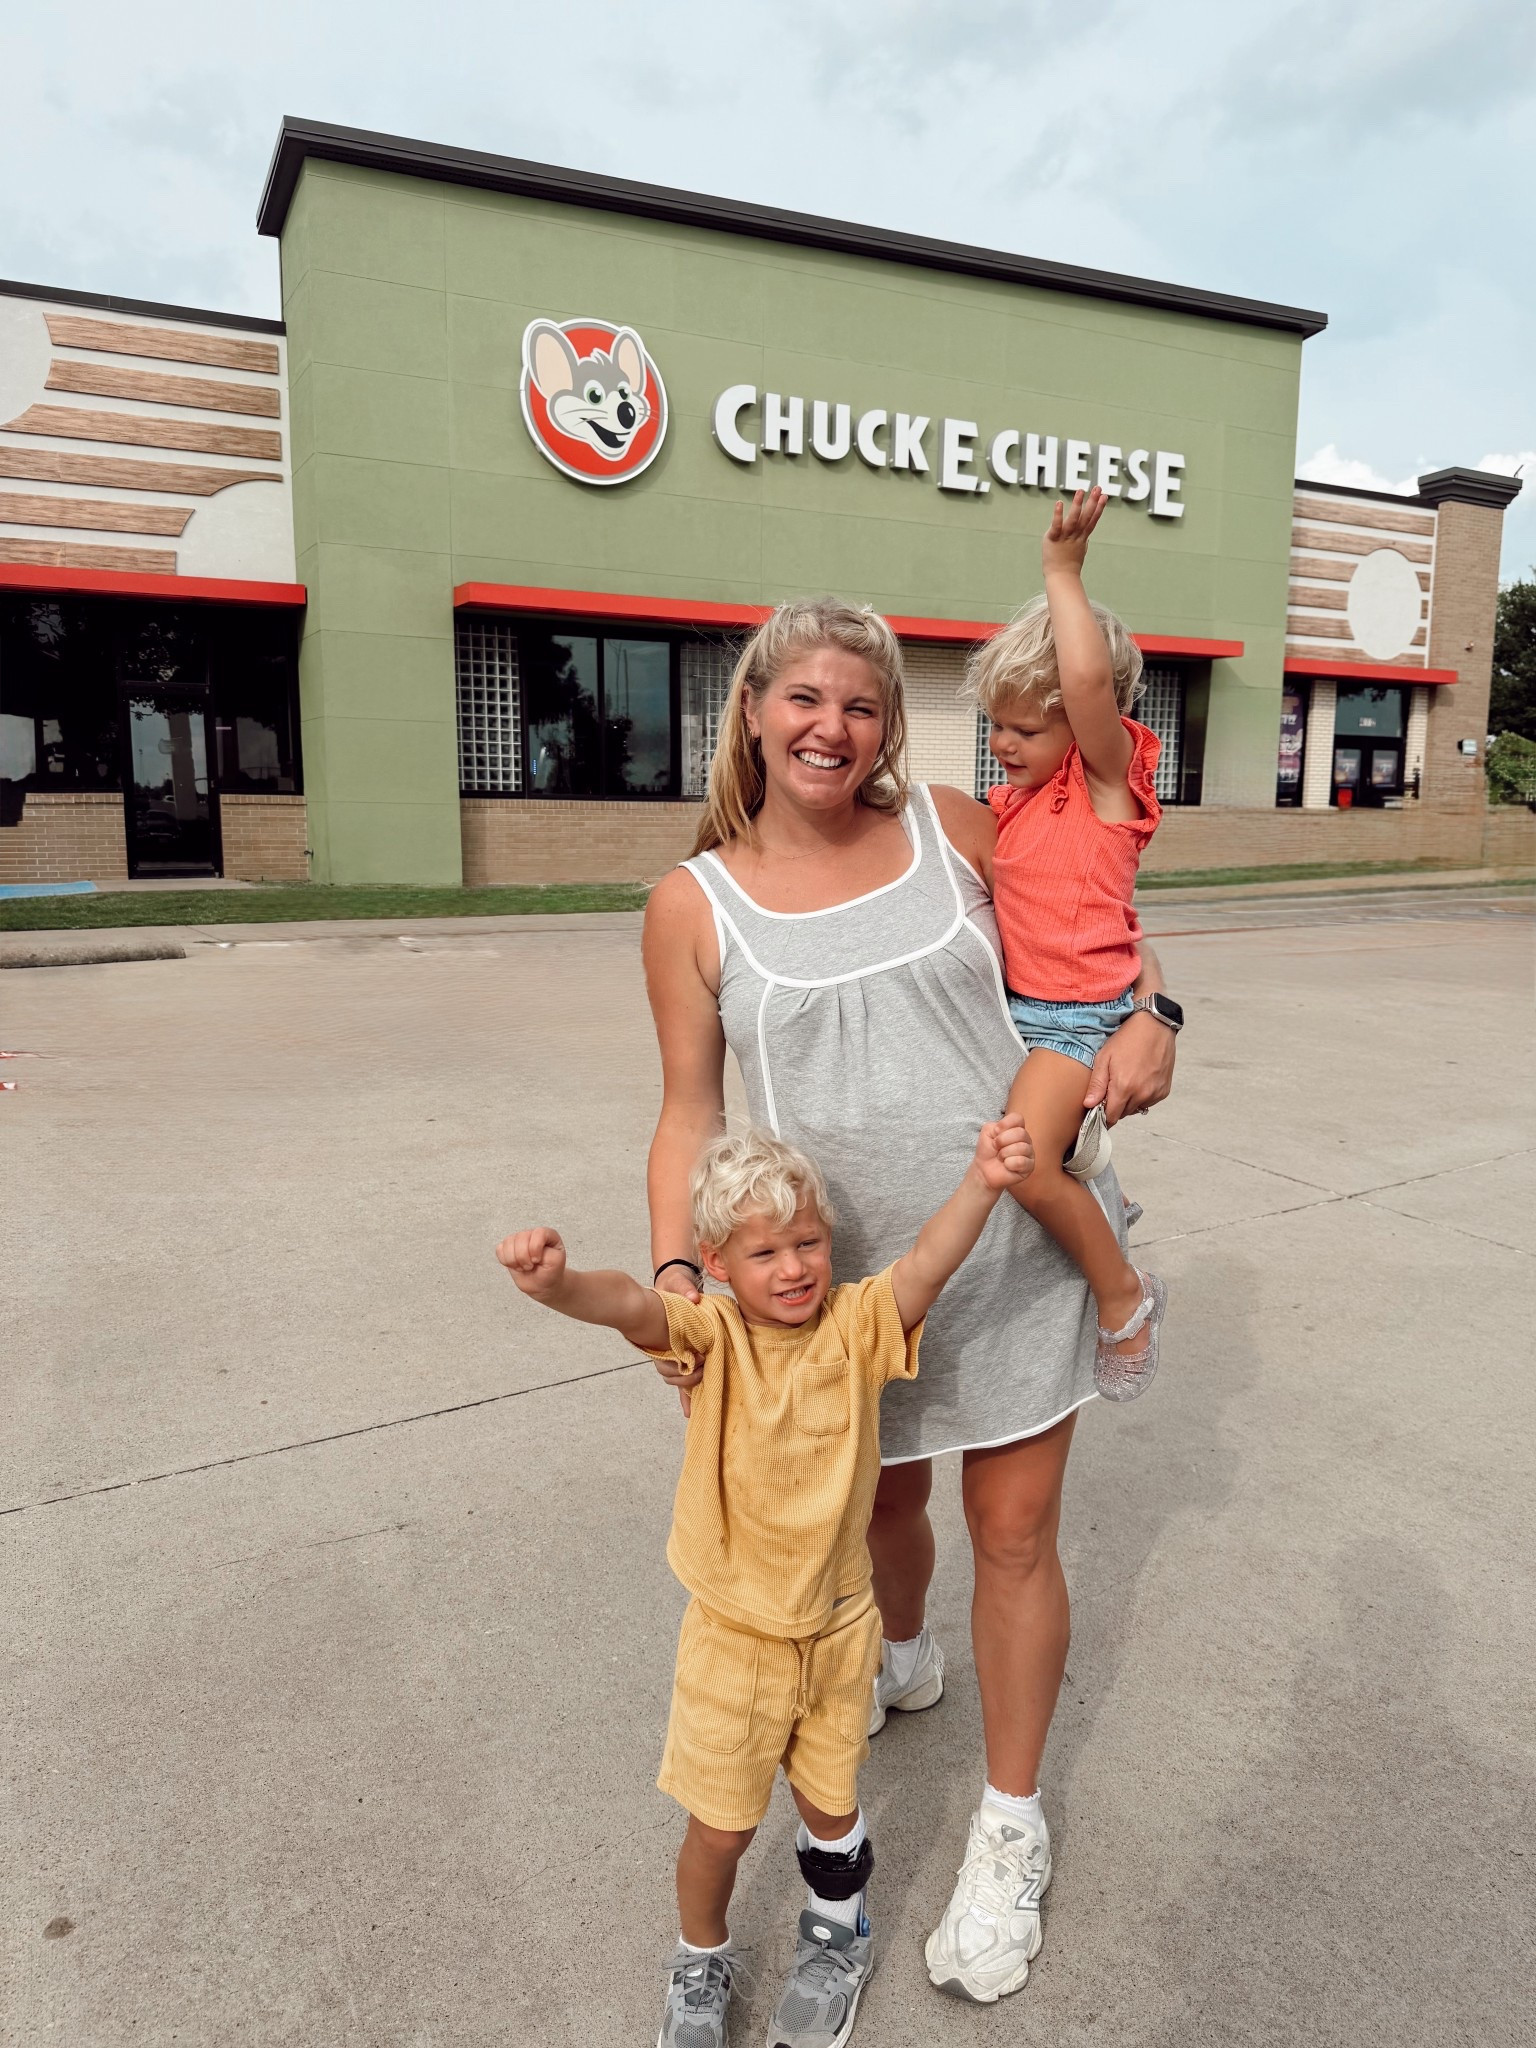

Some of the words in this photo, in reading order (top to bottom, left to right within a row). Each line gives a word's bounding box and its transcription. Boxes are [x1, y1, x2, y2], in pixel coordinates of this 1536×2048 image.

[712, 384, 930, 472] CHUCK
[937, 418, 991, 493] E.
[986, 429, 1185, 518] CHEESE
